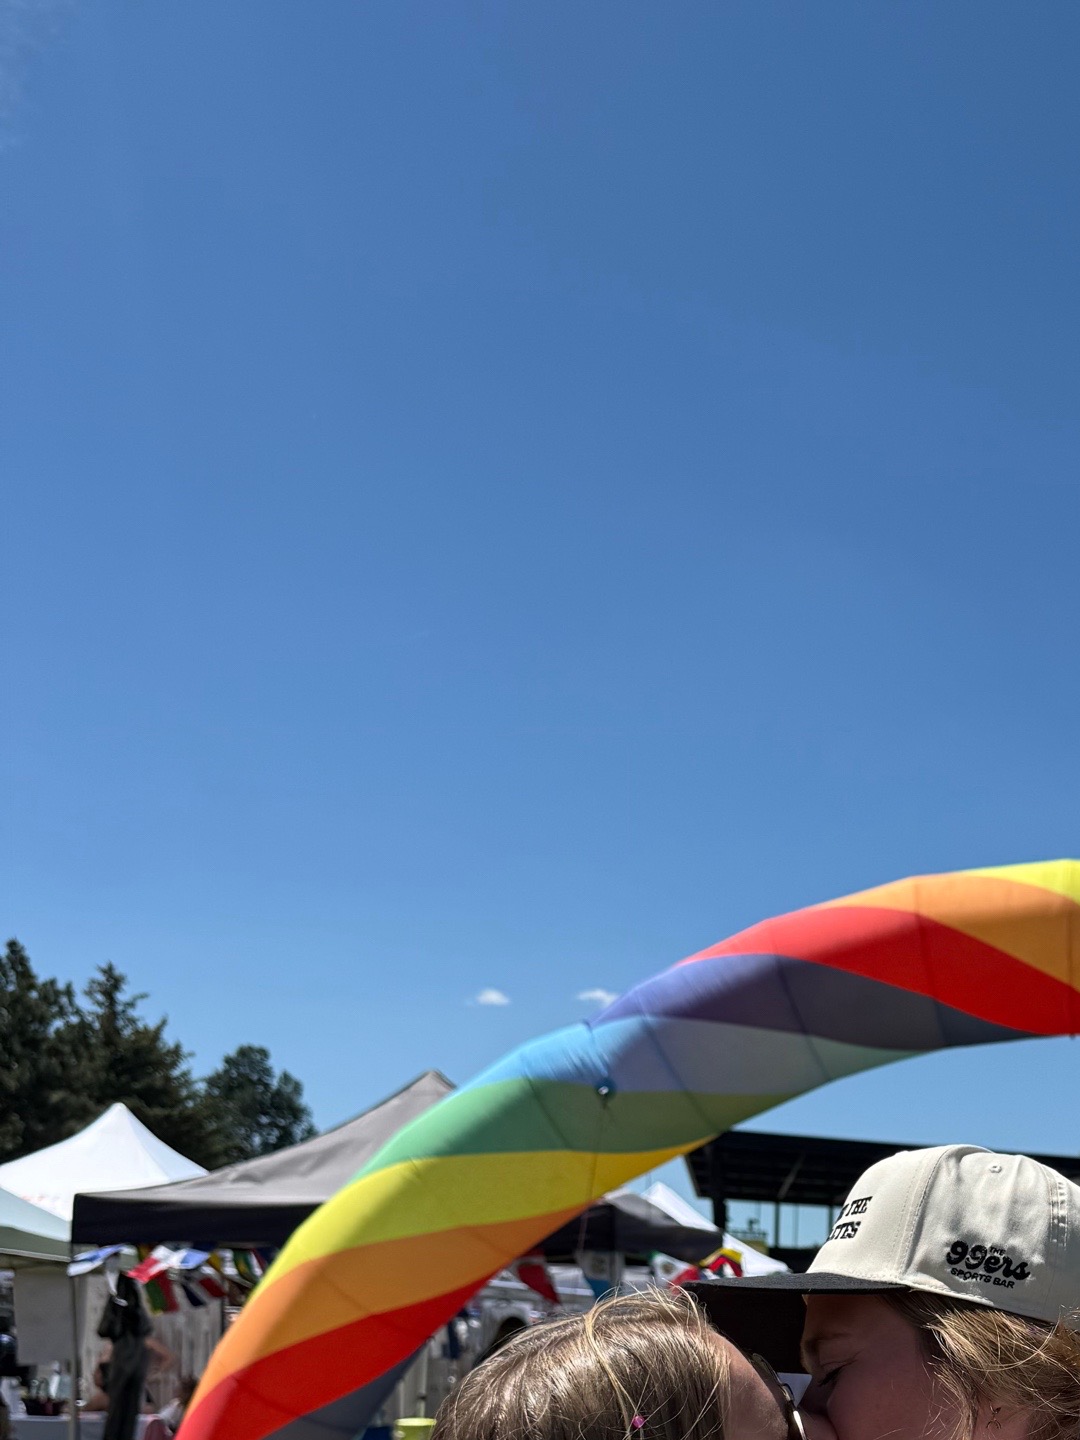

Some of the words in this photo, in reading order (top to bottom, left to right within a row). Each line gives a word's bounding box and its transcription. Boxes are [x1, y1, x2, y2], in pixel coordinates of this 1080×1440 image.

[946, 1240, 1031, 1280] 99ers
[990, 1246, 1006, 1255] THE
[950, 1267, 992, 1283] SPORTS
[993, 1277, 1015, 1289] BAR
